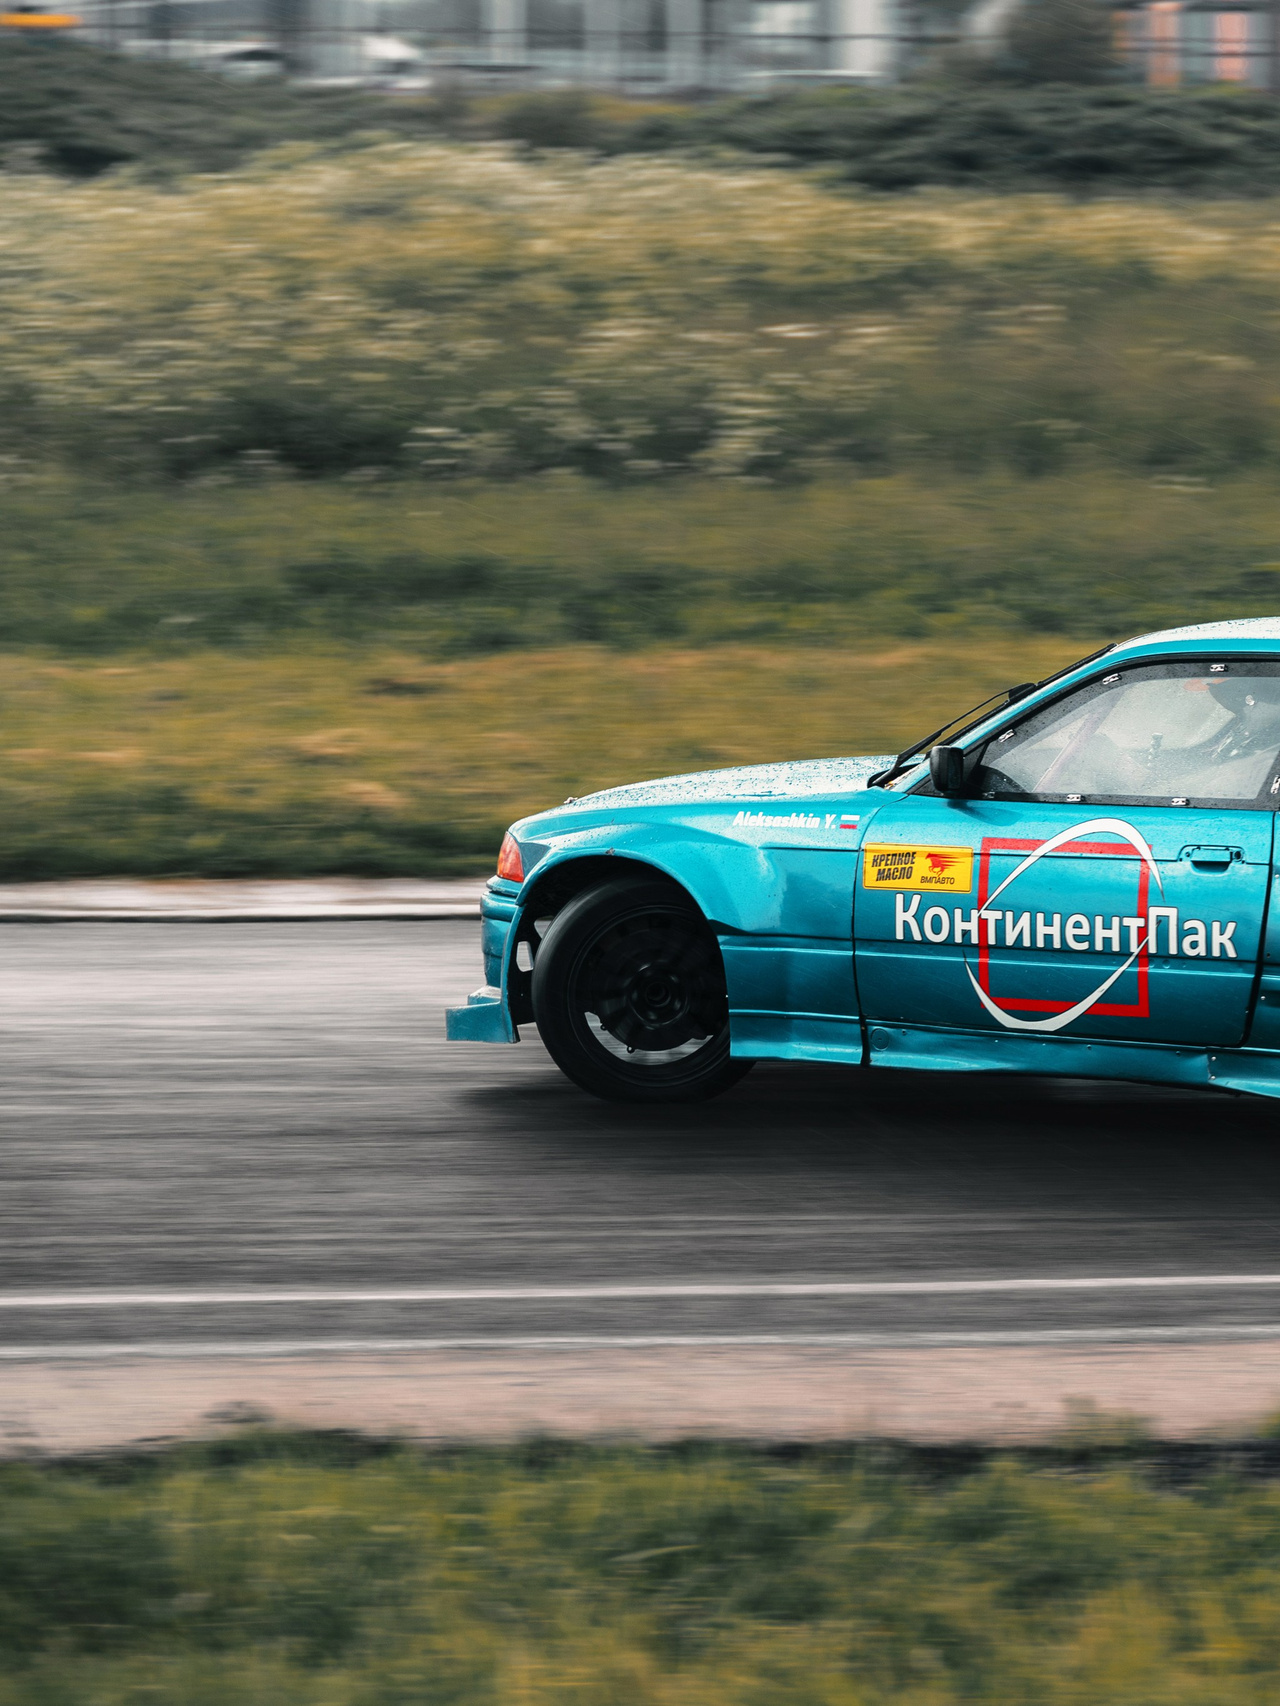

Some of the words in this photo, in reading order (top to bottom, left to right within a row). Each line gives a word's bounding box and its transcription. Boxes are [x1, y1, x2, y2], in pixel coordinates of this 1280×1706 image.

[732, 811, 820, 829] Aleksashkin
[825, 813, 837, 829] Y.
[871, 851, 917, 868] КРЕПКОЕ
[875, 866, 914, 882] МАСЛО
[920, 876, 955, 885] ВМПАВТО
[894, 892, 1238, 959] КонтинентПак
